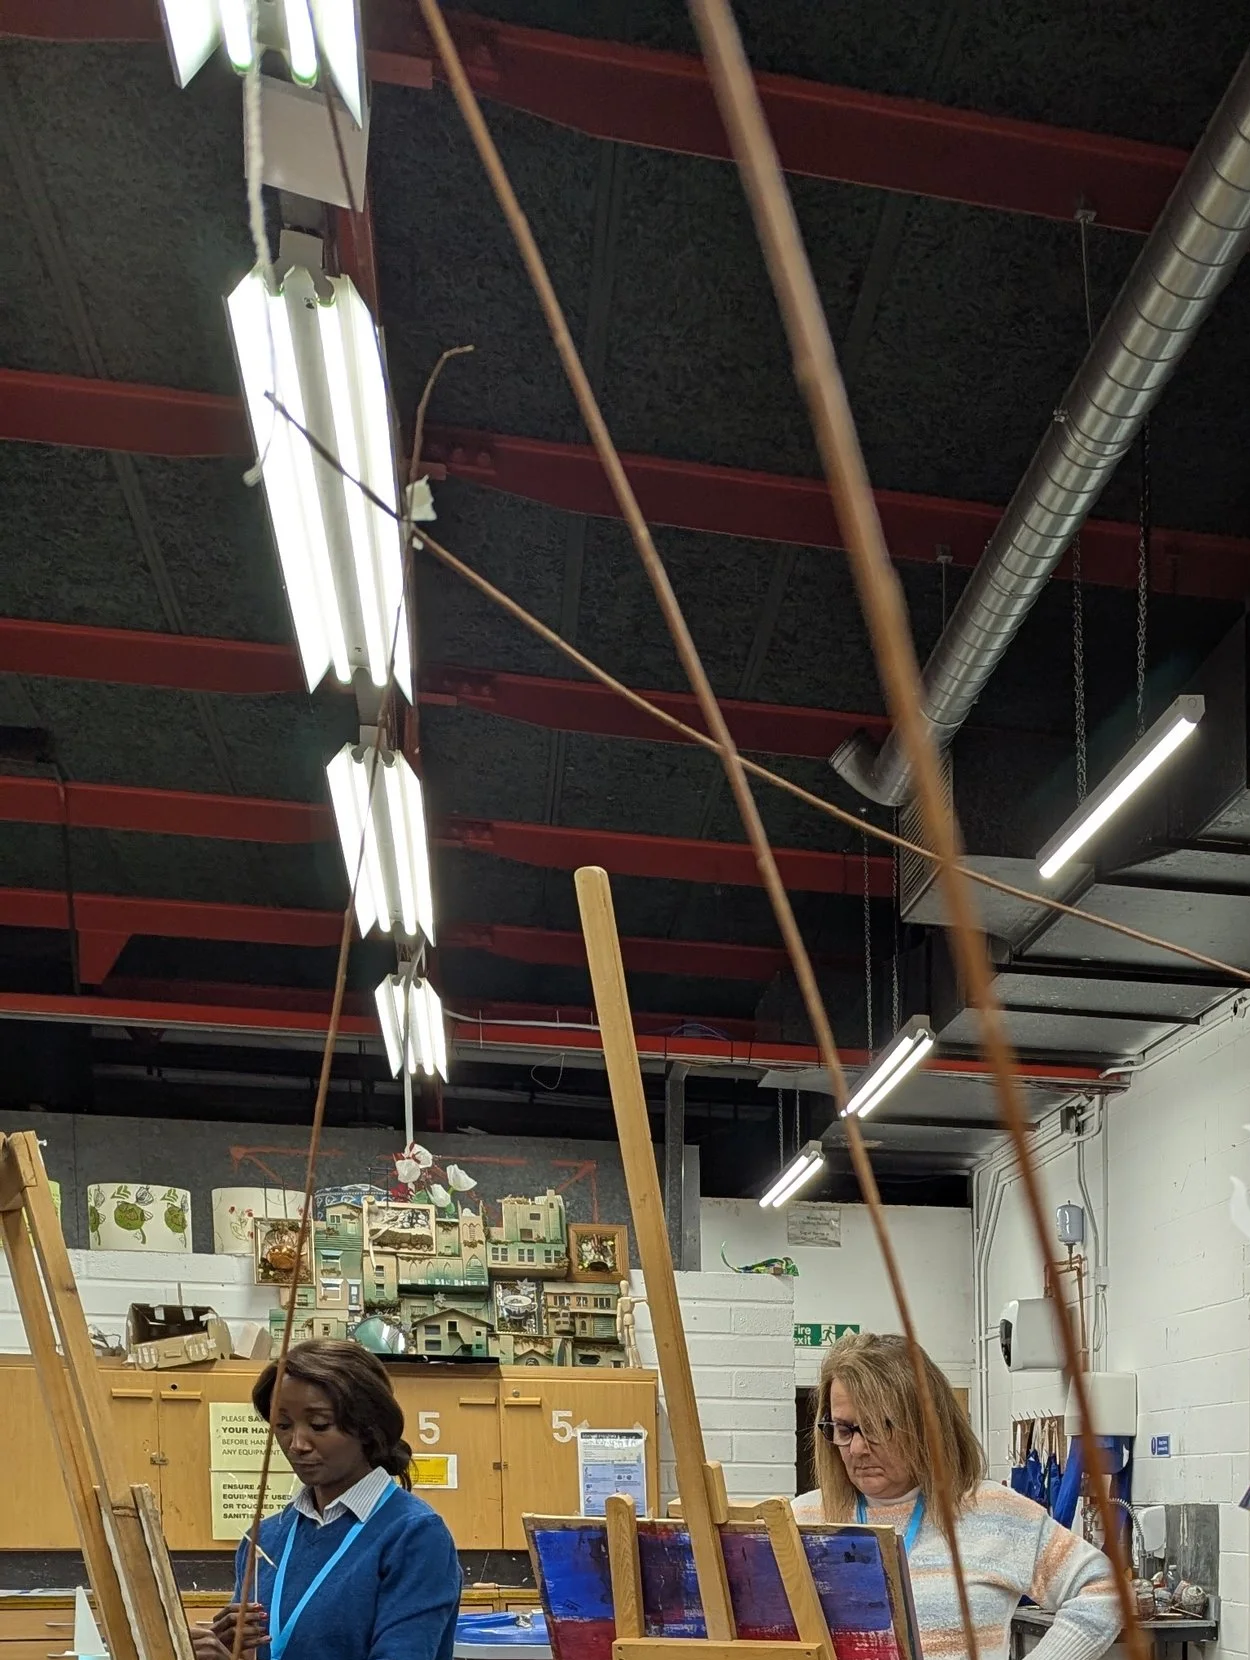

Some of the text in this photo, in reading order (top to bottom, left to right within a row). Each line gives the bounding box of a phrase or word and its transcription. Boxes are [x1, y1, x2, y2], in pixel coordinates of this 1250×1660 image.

[221, 1415, 246, 1423] PLEASE
[221, 1426, 249, 1434] YOUR
[419, 1411, 440, 1445] 5
[552, 1410, 573, 1443] 5
[221, 1438, 249, 1446] BEFORE
